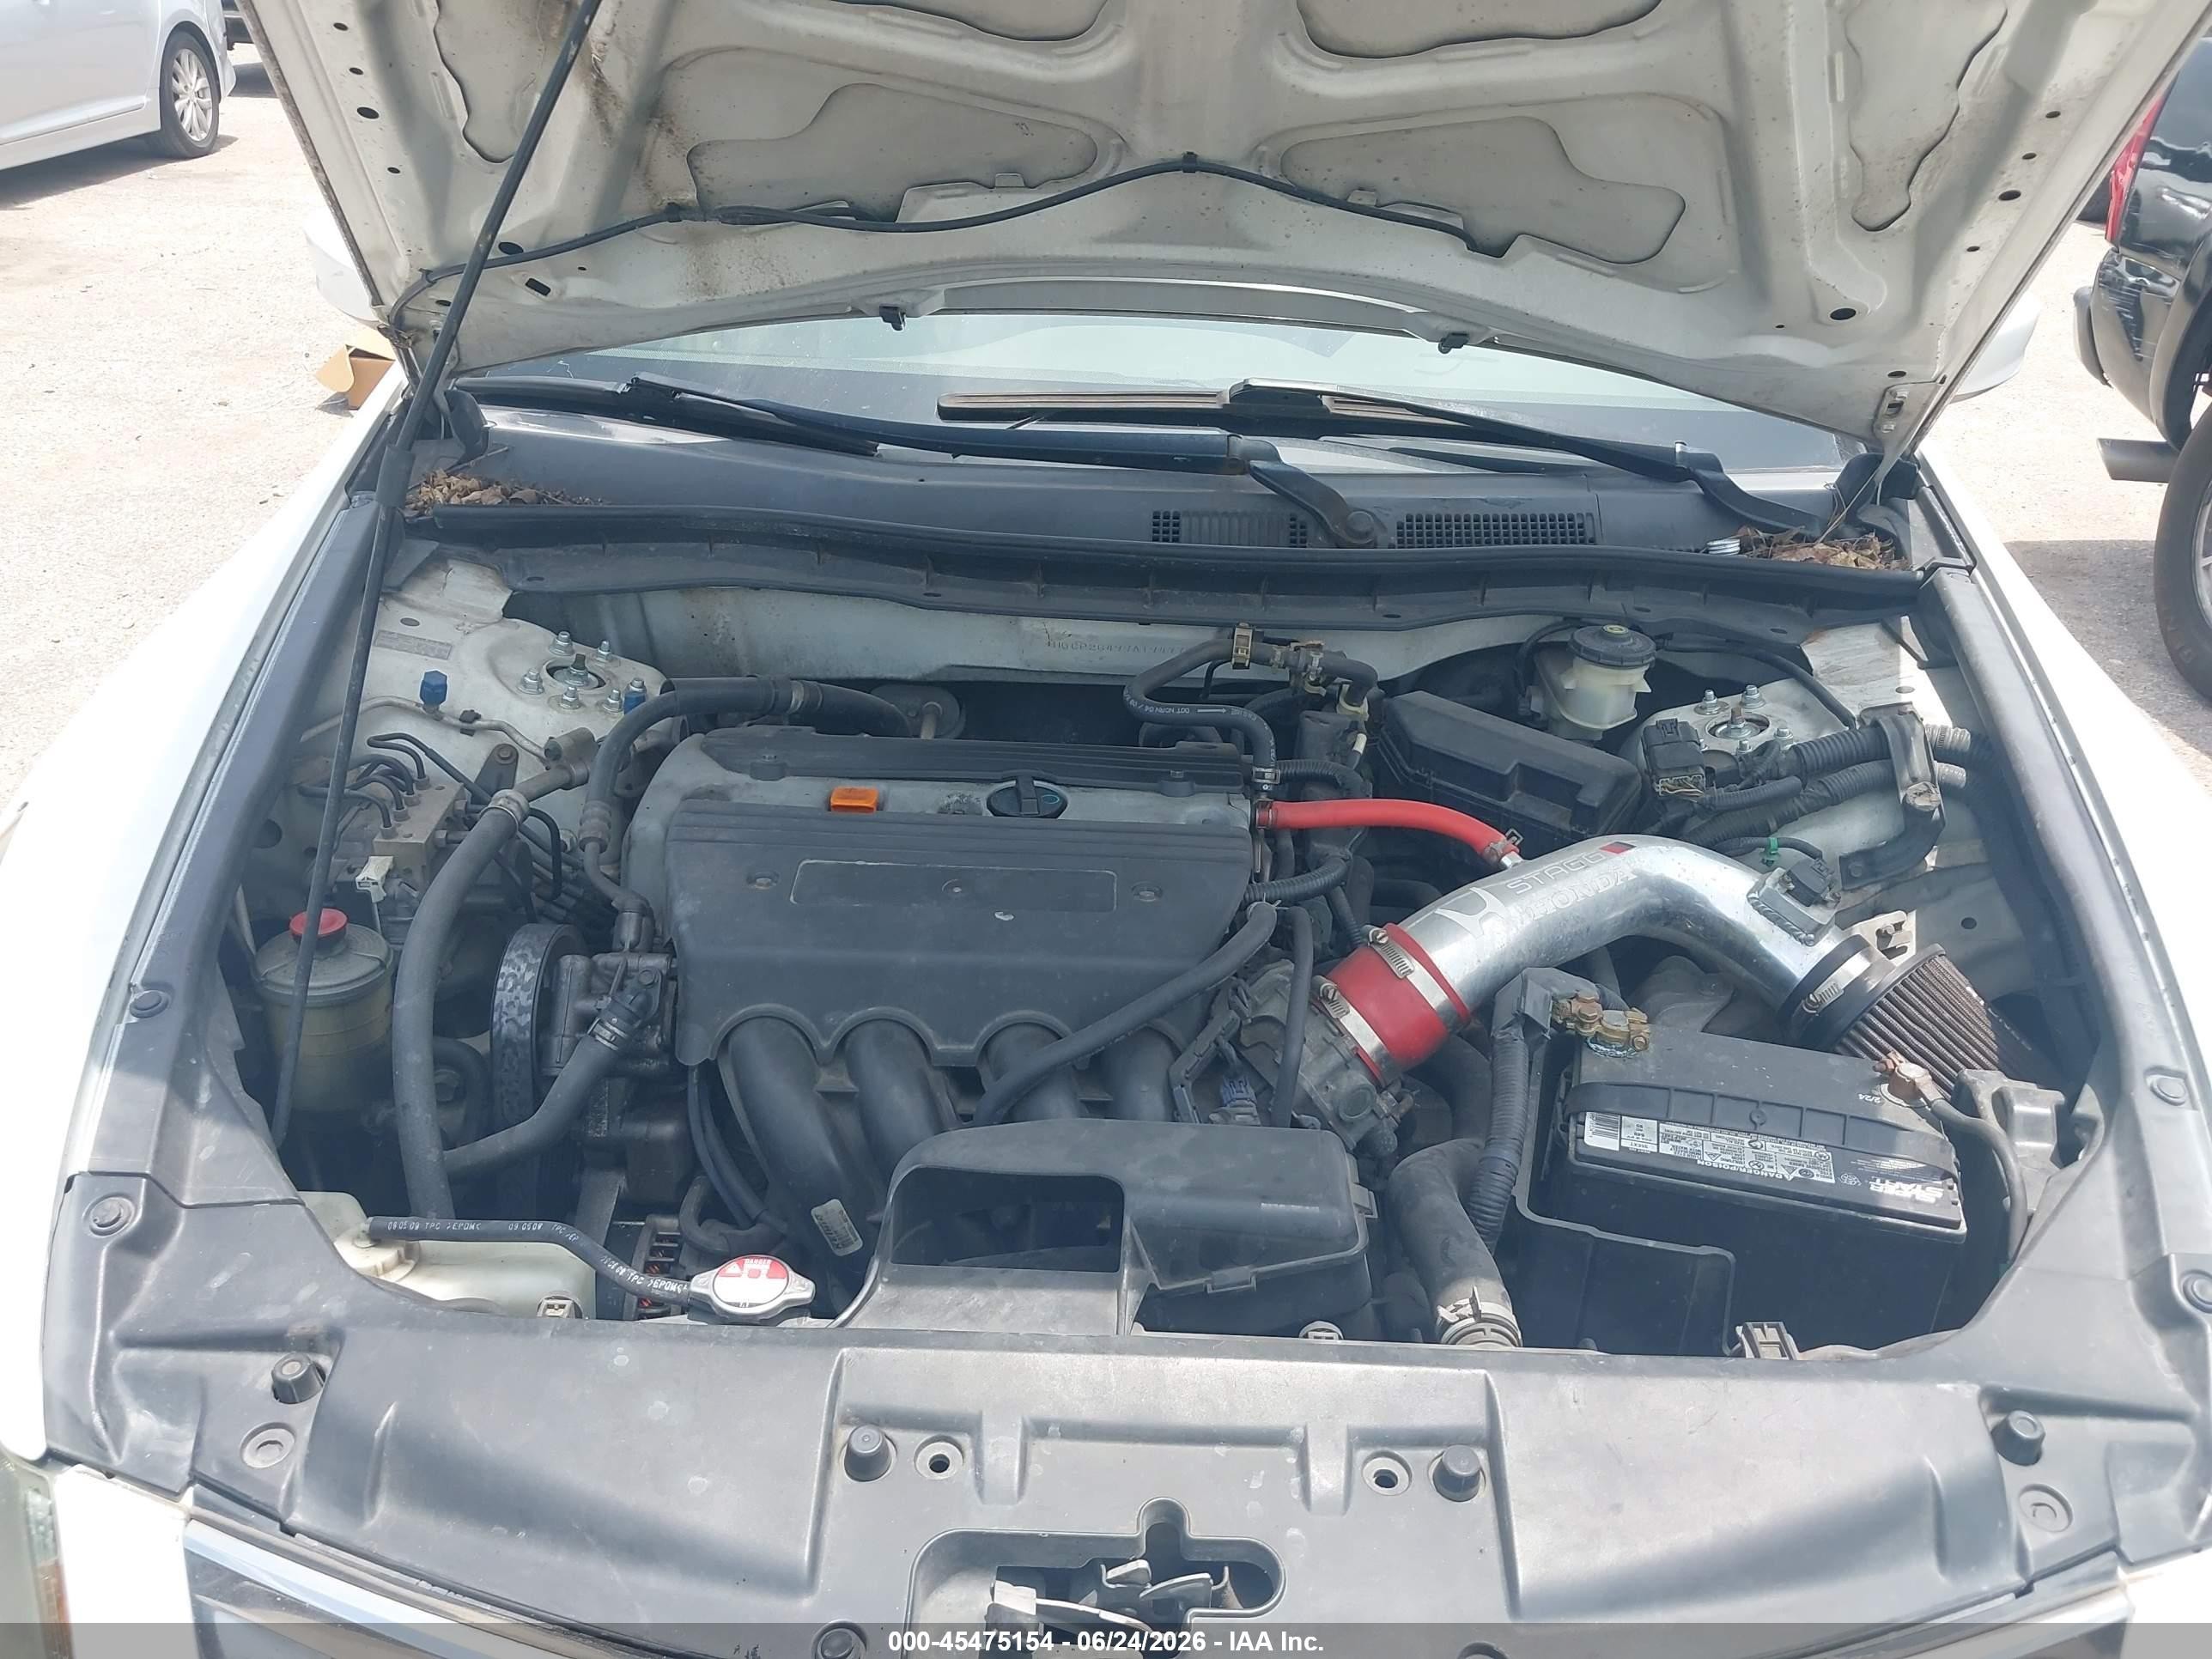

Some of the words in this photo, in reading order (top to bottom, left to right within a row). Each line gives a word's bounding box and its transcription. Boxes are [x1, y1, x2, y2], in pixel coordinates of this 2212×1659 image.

[1507, 851, 1605, 895] STAGG
[1532, 868, 1638, 920] HONDA
[1697, 1159, 1783, 1179] DANGER/POISON
